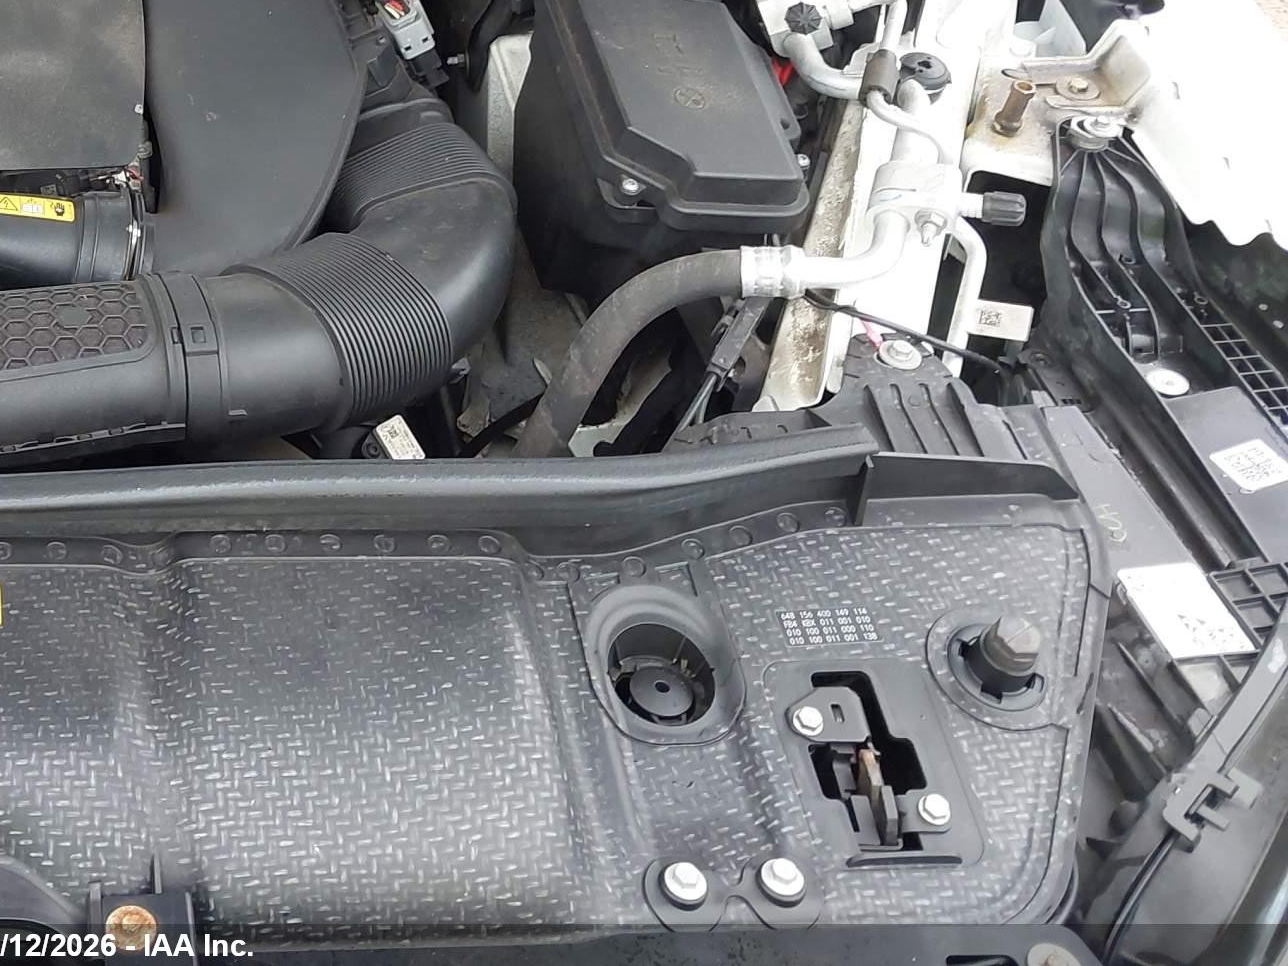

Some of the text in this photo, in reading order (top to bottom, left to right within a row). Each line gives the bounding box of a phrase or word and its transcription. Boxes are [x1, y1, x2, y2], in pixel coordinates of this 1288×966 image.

[819, 618, 834, 626] 011
[855, 615, 871, 624] 010
[786, 628, 802, 637] 010
[805, 626, 820, 635] 100
[822, 626, 838, 634] 011
[859, 623, 874, 632] 110
[789, 636, 805, 645] 010
[825, 634, 841, 643] 011
